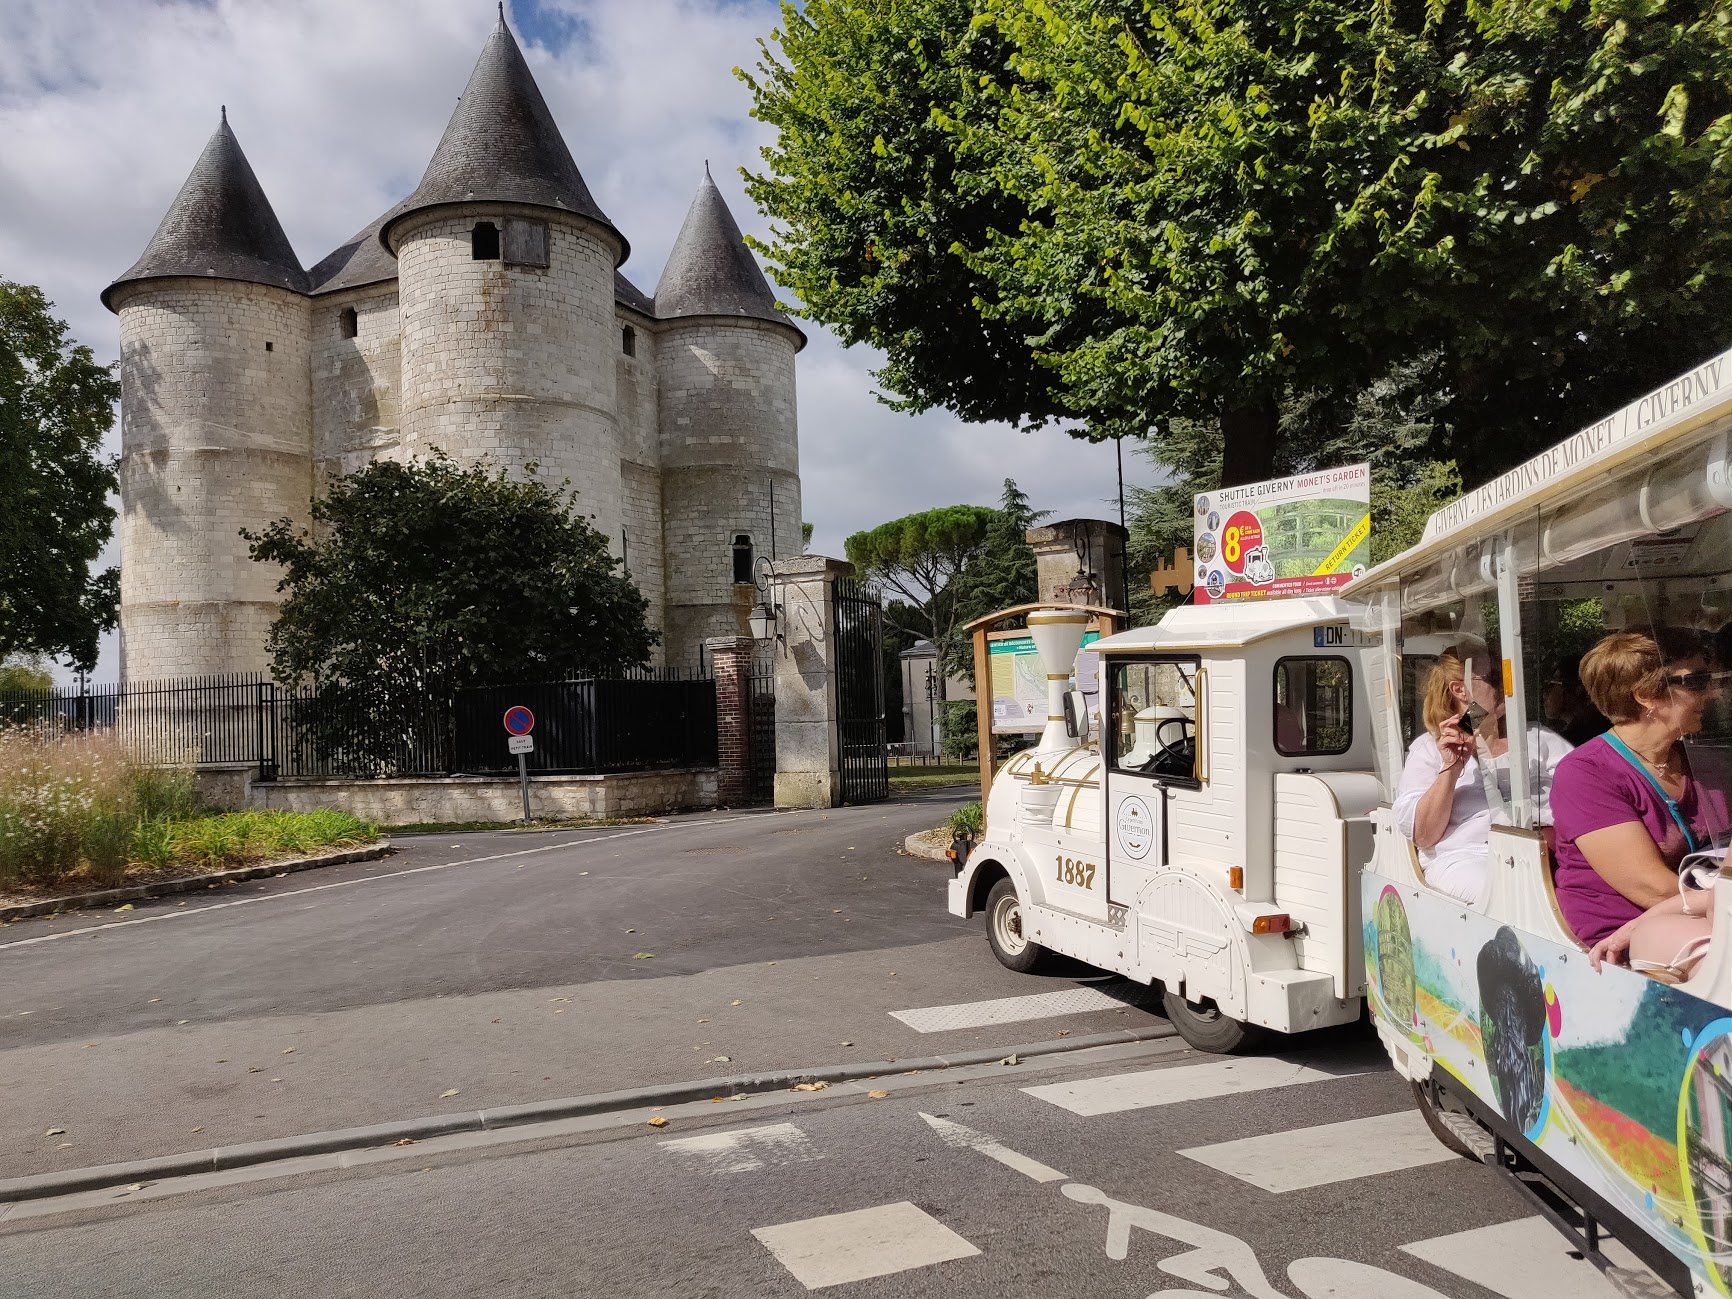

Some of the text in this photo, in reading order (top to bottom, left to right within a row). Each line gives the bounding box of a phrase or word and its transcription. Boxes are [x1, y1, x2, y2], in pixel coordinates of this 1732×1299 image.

[1435, 496, 1470, 535] GIVERNY
[1475, 485, 1493, 513] LES
[1541, 448, 1559, 480] DE
[1562, 415, 1616, 470] MONET
[1636, 357, 1724, 431] GIVERNY
[1219, 468, 1366, 503] SHUTTLE GIVERNY MONET'S GARDEN
[1325, 546, 1347, 571] RETURN
[1346, 524, 1366, 547] TICKET
[1055, 855, 1096, 890] 1887
